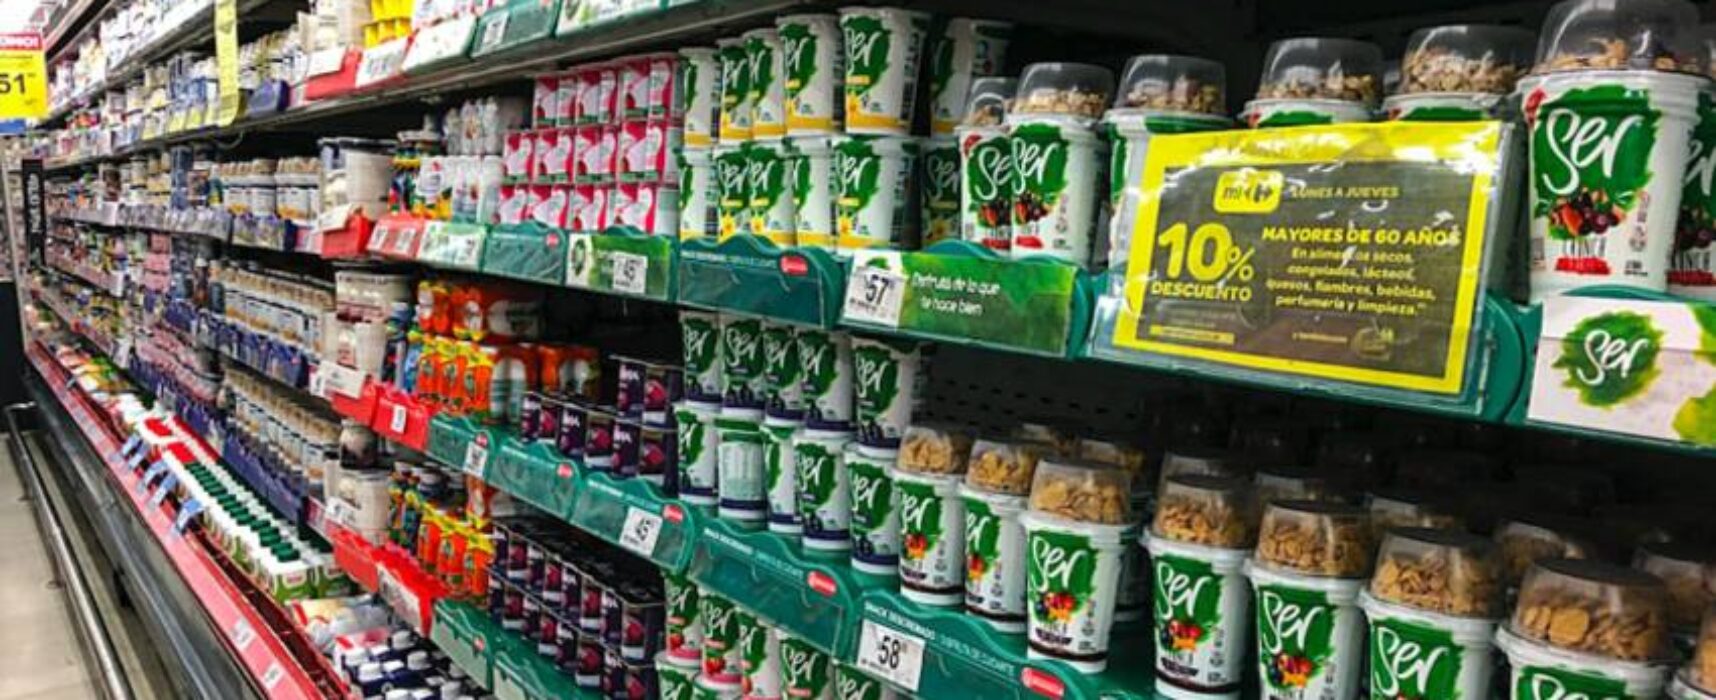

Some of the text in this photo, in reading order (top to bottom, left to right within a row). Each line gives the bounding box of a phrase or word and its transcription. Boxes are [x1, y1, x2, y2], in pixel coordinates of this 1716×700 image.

[835, 150, 873, 197] Ser
[1012, 137, 1060, 194] Ser
[1542, 108, 1645, 195] Ser
[1345, 186, 1400, 199] JUEVES
[1158, 221, 1256, 282] 10%
[1262, 227, 1344, 243] MAYORES
[1346, 228, 1371, 244] DE
[1374, 229, 1400, 245] 60
[1151, 281, 1253, 302] DESCUENTO
[726, 328, 762, 368] Ser
[1576, 329, 1650, 387] Ser
[1031, 535, 1088, 593] Ser
[1157, 561, 1213, 620] Ser
[1262, 591, 1326, 655] Ser
[877, 634, 900, 671] 58
[1374, 626, 1450, 697] Ser
